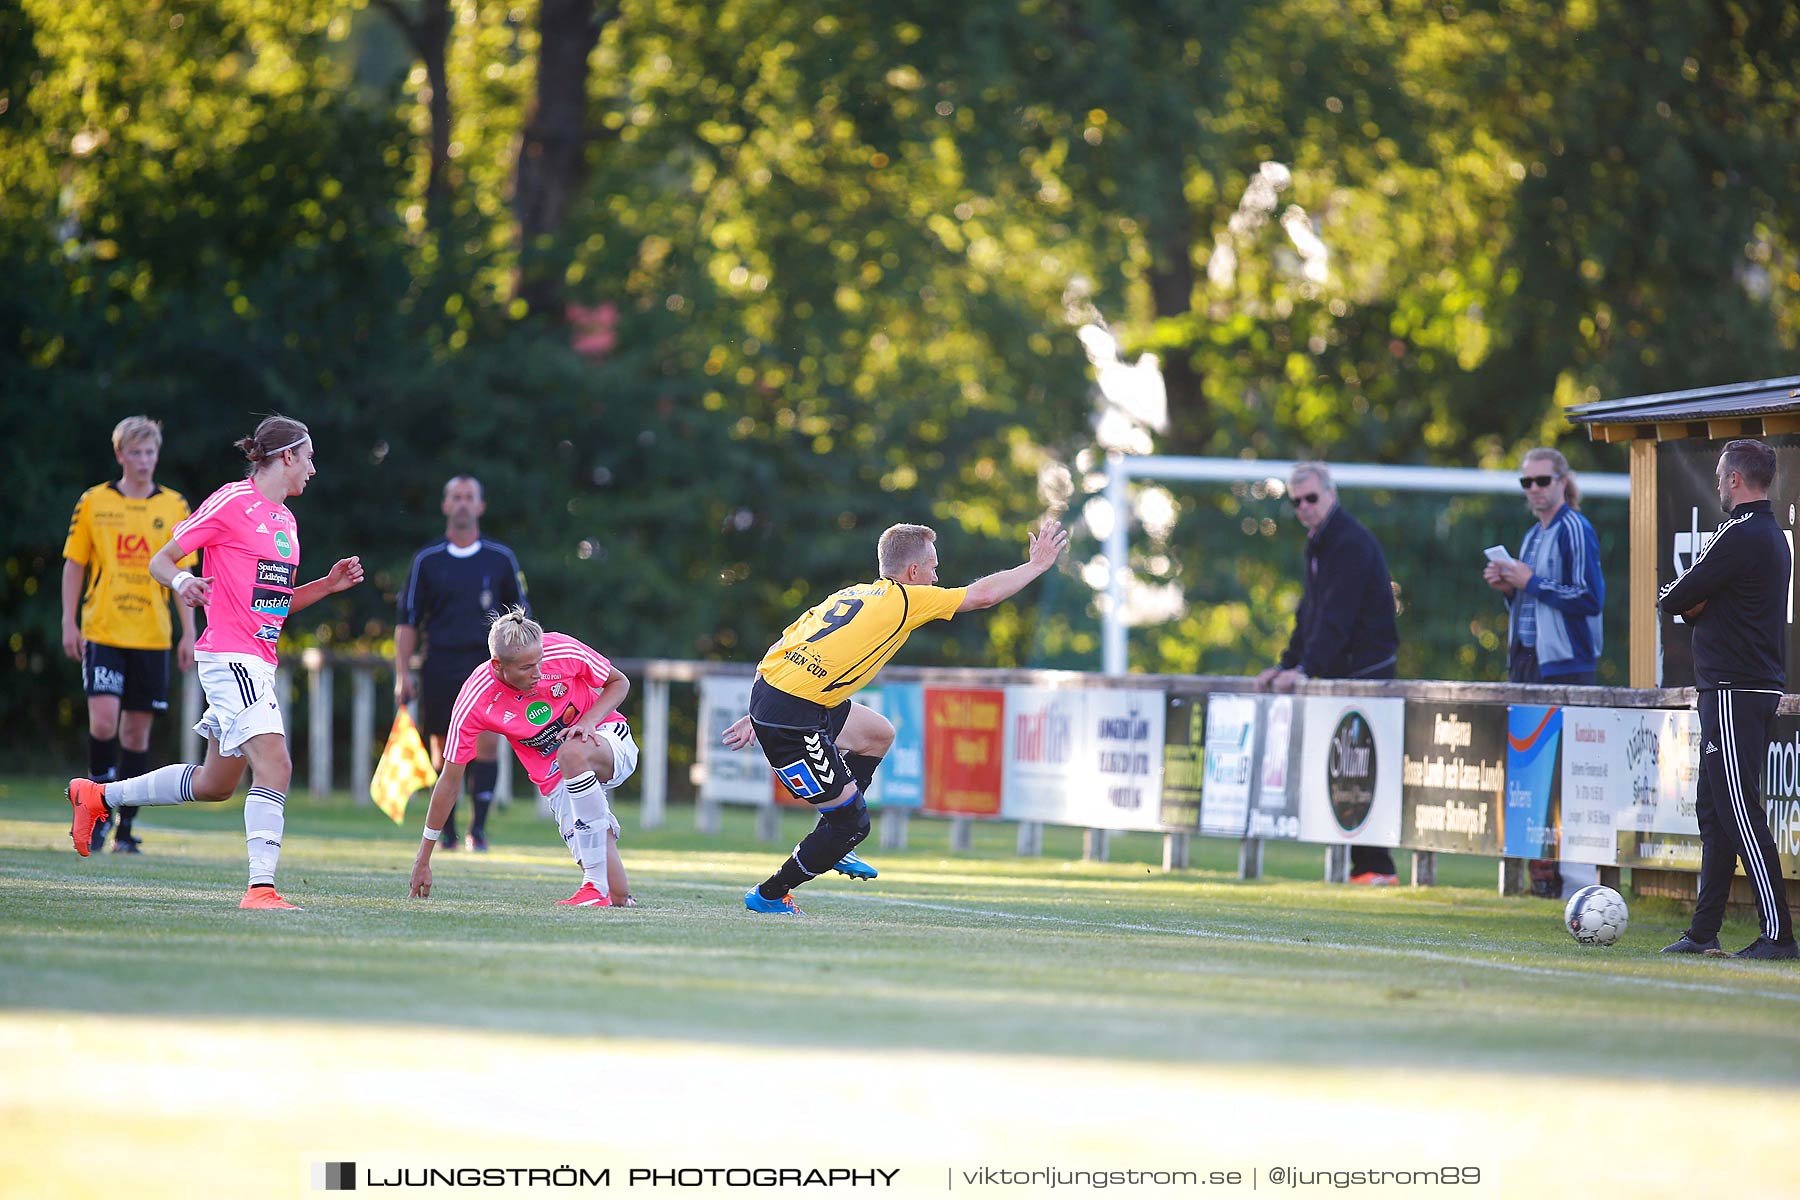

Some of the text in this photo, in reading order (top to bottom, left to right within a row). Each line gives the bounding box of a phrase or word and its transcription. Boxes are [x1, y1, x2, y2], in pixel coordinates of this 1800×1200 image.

[116, 533, 150, 554] ICA
[805, 599, 865, 643] 9
[806, 663, 828, 679] CUP
[528, 705, 550, 720] dina
